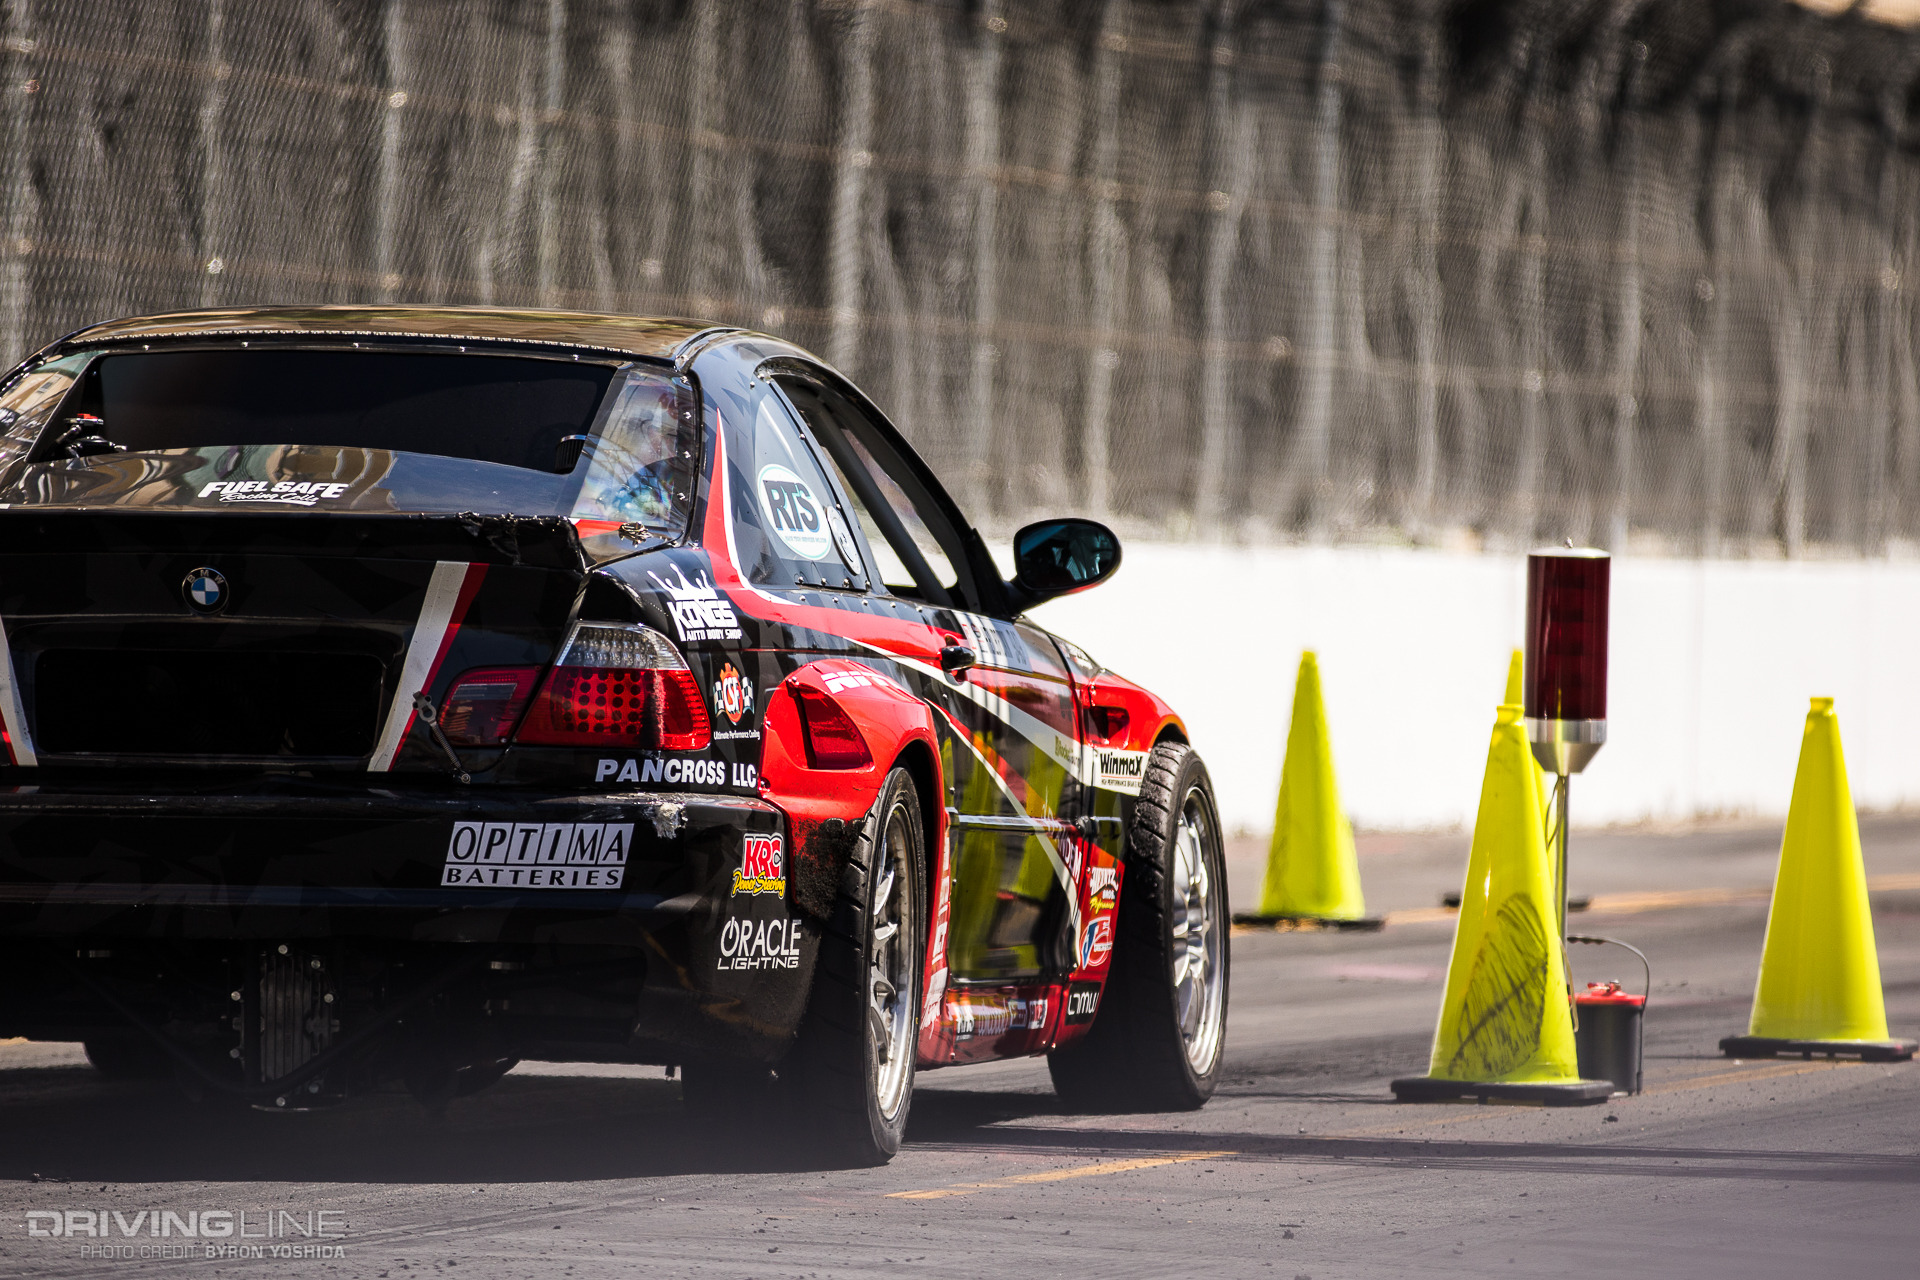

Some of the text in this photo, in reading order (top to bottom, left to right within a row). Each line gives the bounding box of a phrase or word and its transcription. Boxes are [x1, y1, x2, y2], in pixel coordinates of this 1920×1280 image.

[198, 481, 349, 499] FUEL SAFE
[219, 492, 279, 502] Racing
[763, 480, 820, 533] RTS
[187, 569, 225, 585] BMW
[666, 599, 739, 642] KINGS
[686, 629, 706, 641] AUTO
[725, 628, 743, 640] SHOP
[723, 677, 741, 714] CSF
[713, 730, 729, 740] Ultimate
[595, 758, 757, 789] PANCROSS LLC
[1100, 752, 1143, 777] WinmaX
[452, 825, 624, 862] OPTIMA
[743, 837, 782, 878] KRC
[446, 867, 620, 886] BATTERIES
[732, 869, 786, 898] Power Steering
[721, 915, 802, 958] ORACLE
[717, 956, 800, 970] LIGHTING
